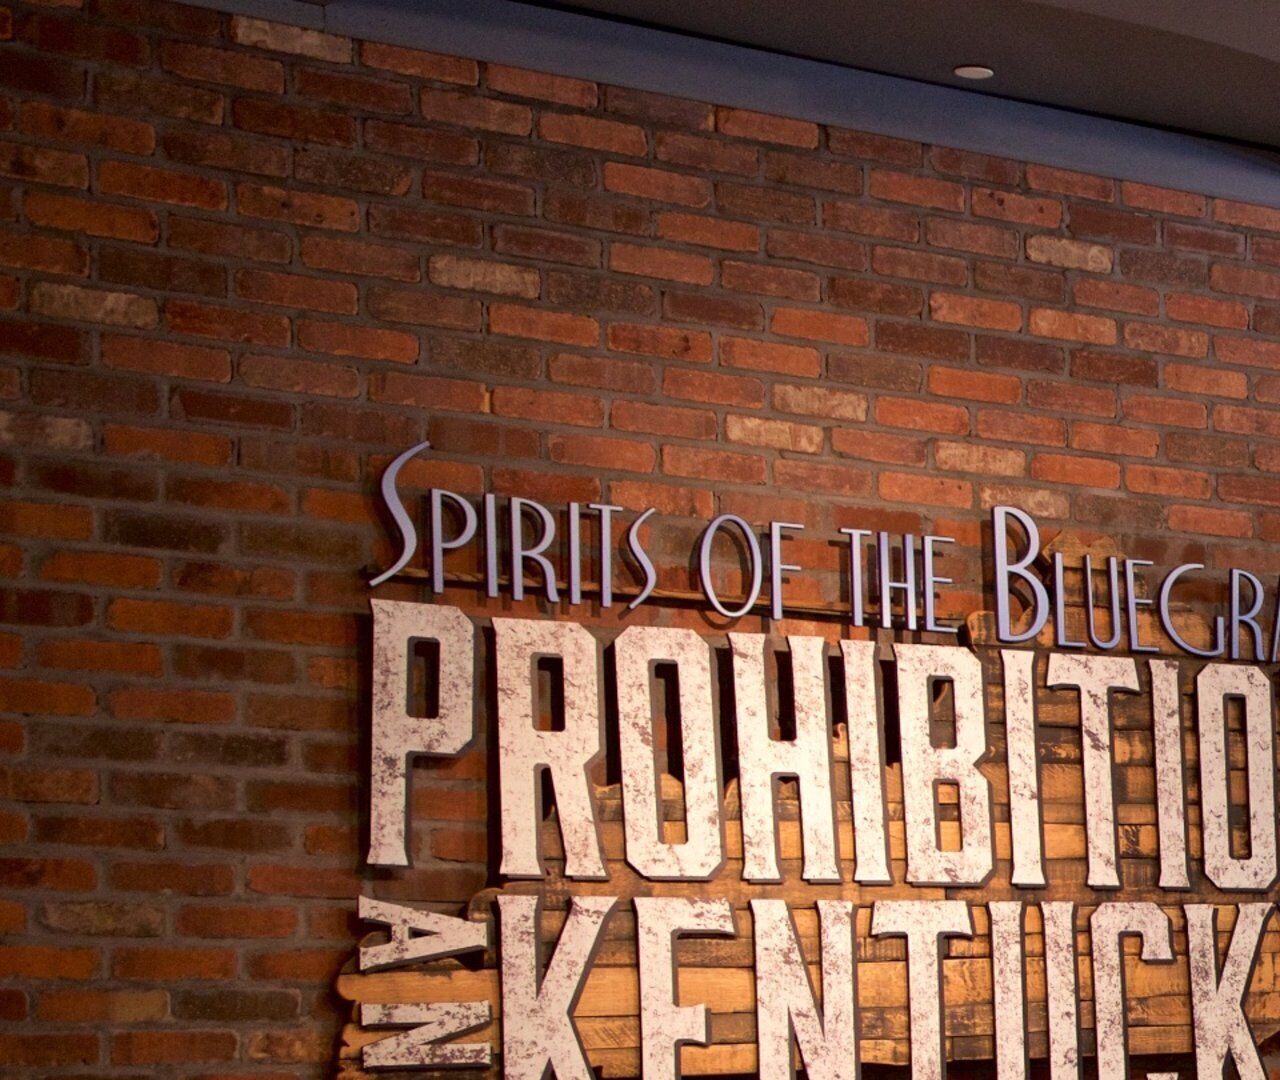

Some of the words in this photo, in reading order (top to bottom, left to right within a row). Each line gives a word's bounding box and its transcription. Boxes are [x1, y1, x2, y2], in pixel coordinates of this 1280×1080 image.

[368, 441, 657, 609] SPIRITS
[699, 513, 805, 620] OF
[839, 527, 959, 634] THE
